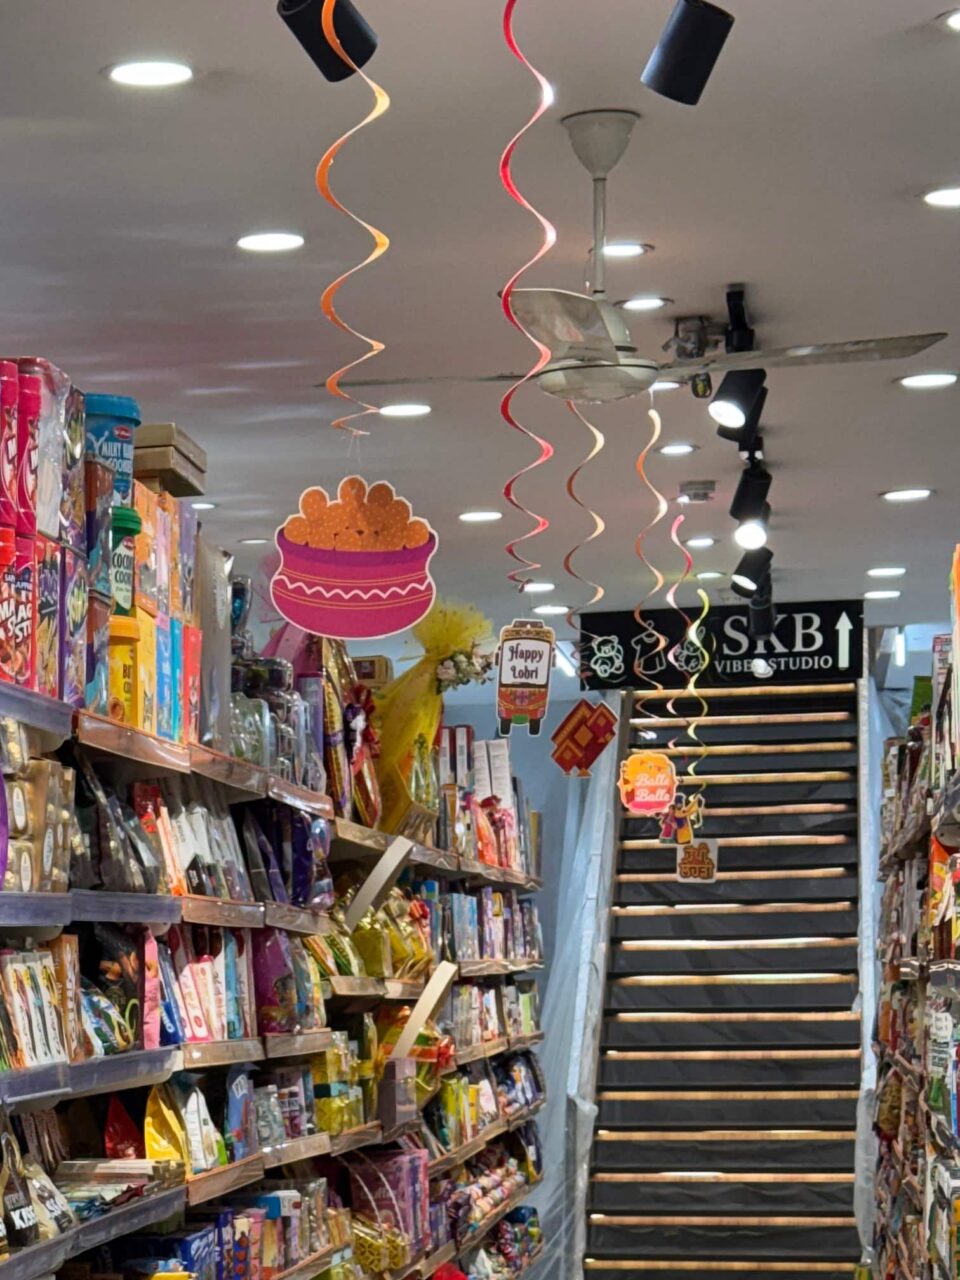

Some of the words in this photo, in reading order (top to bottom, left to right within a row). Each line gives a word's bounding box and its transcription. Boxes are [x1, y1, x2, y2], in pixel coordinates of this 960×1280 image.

[722, 612, 824, 656] SKB
[508, 643, 544, 664] Happy
[714, 659, 754, 674] VIBE
[767, 654, 834, 671] STUDIO
[635, 787, 671, 802] Balle
